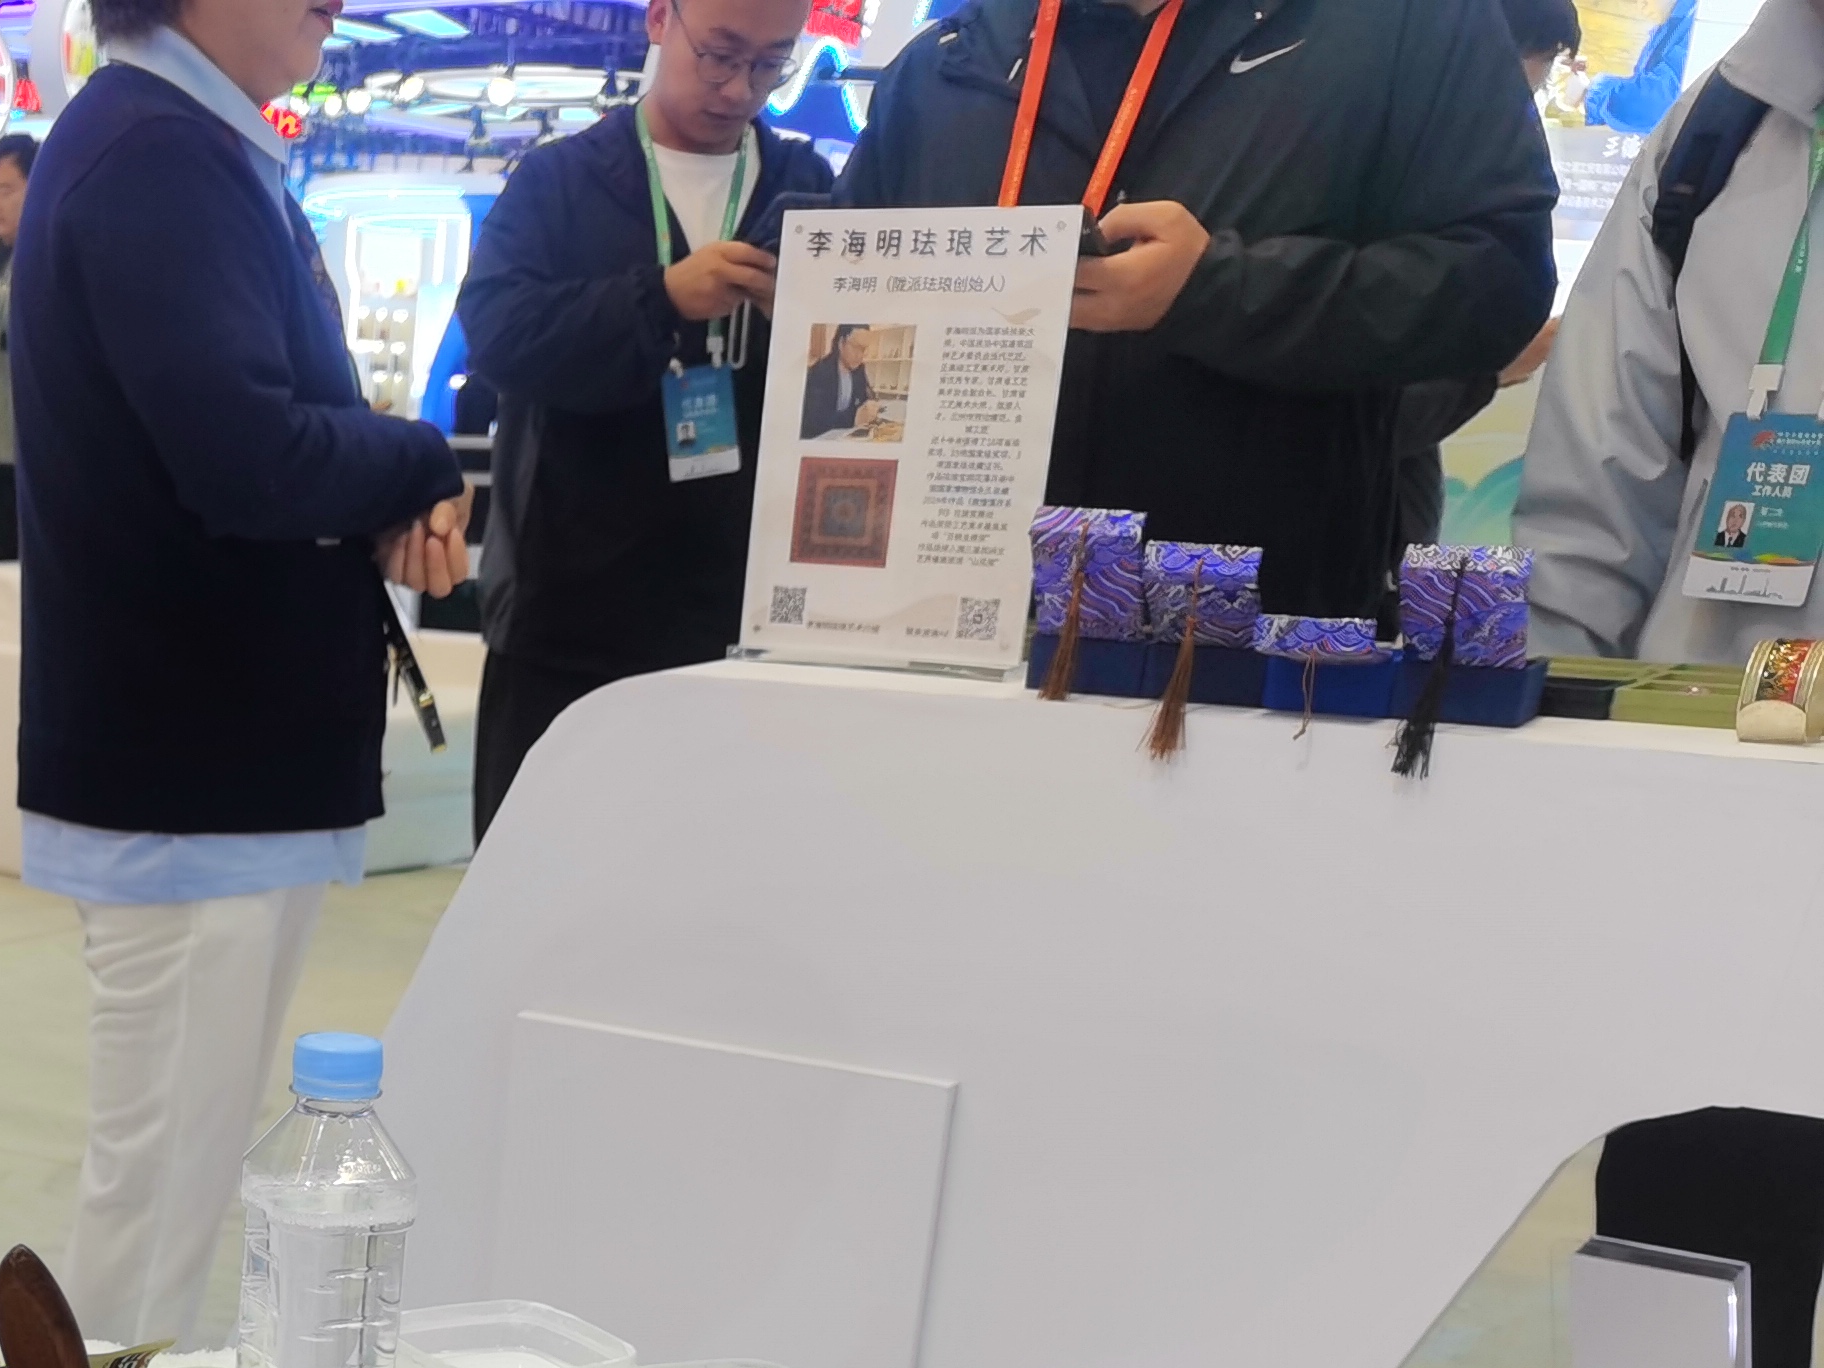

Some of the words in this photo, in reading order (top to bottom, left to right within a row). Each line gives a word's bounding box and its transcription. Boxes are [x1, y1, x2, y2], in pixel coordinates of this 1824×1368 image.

[806, 226, 1049, 257] 李海明珐琅艺术
[1746, 461, 1811, 486] 代表团
[1750, 485, 1794, 499] 工作人员
